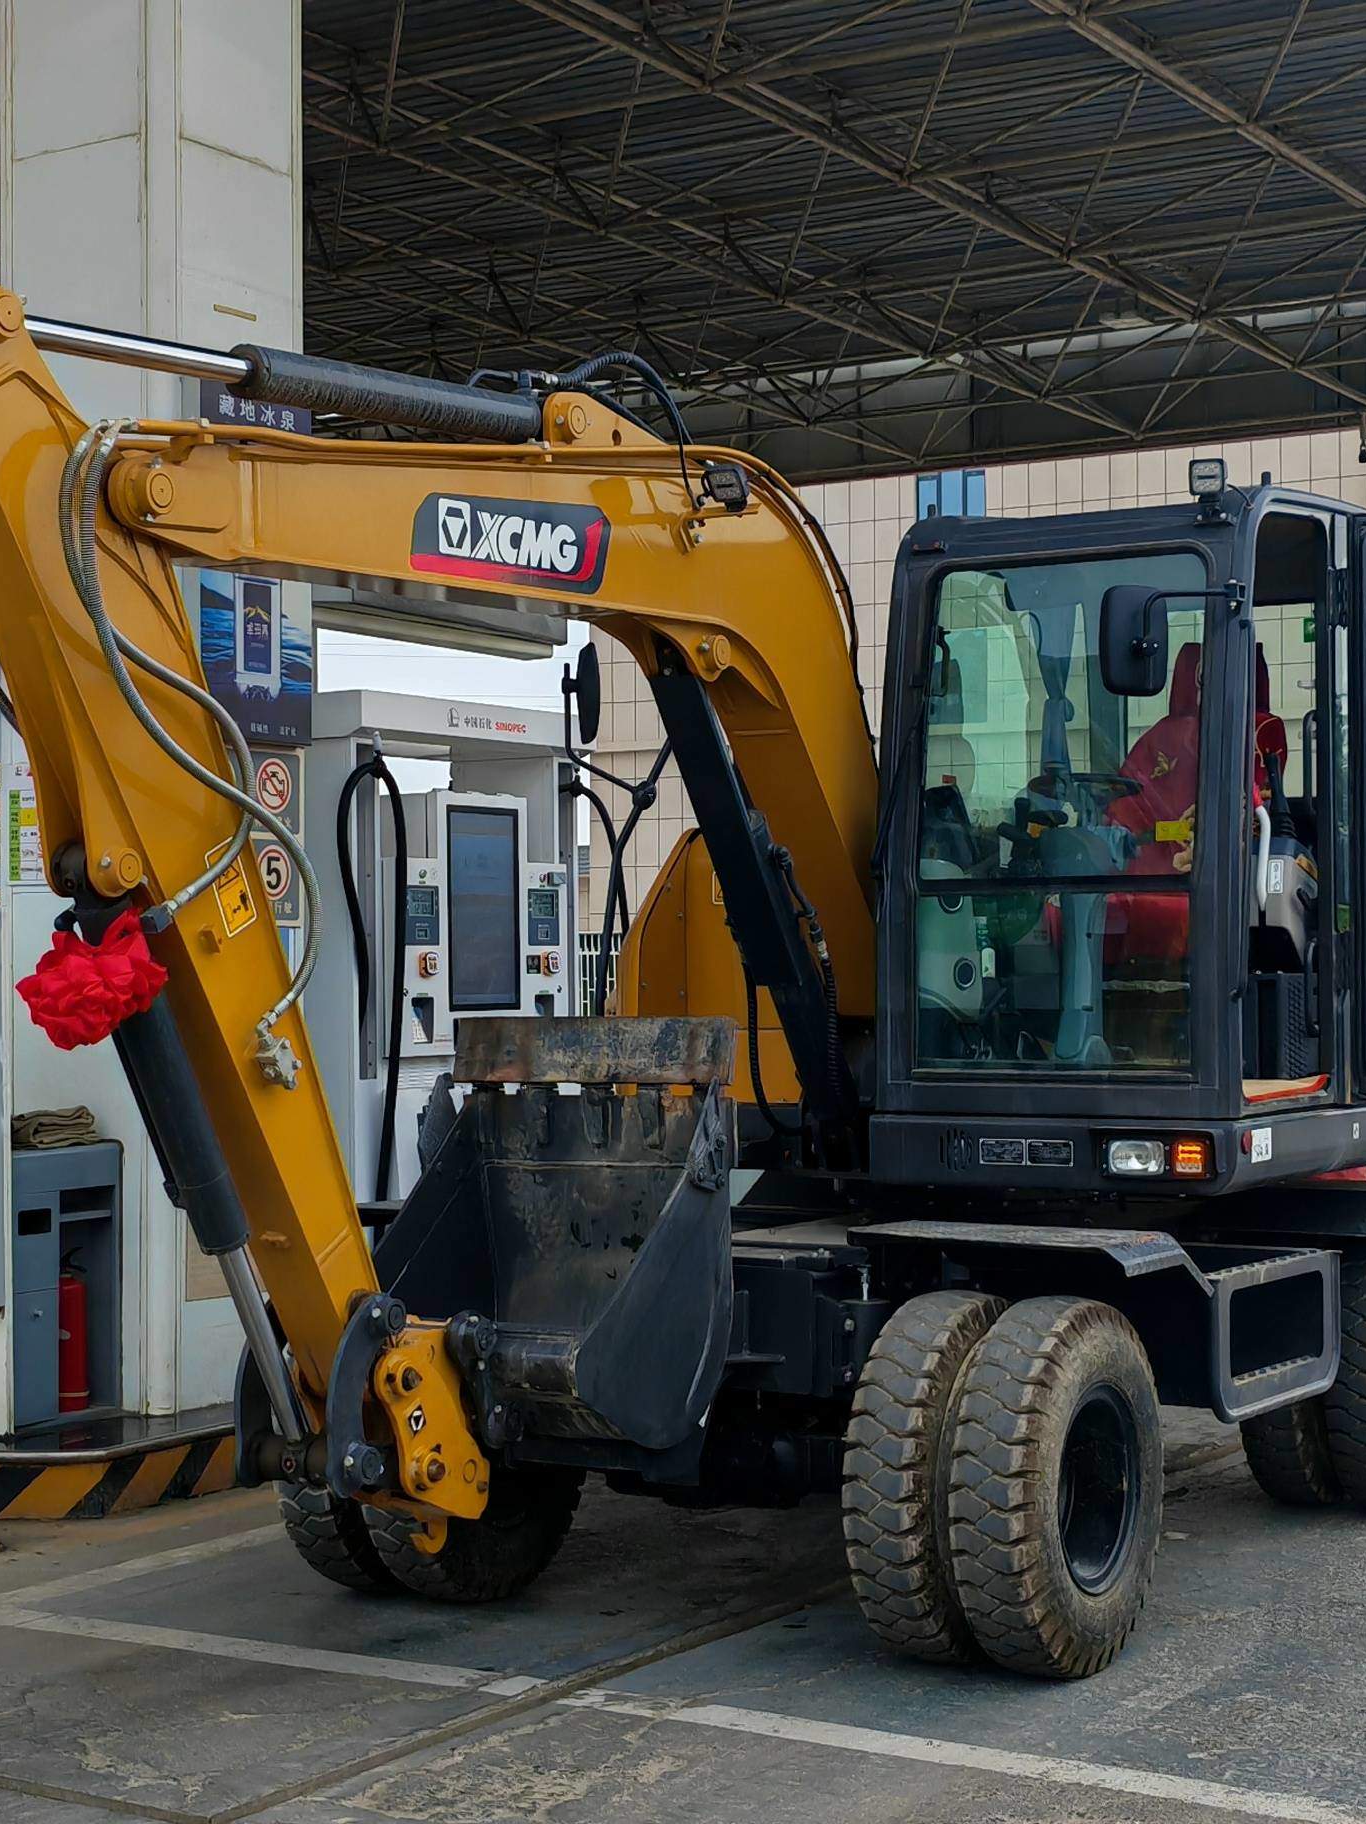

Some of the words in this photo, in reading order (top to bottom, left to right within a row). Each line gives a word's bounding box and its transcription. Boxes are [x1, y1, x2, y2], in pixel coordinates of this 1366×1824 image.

[218, 393, 296, 431] 藏地冰泉
[471, 510, 579, 573] XCMG
[495, 721, 527, 734] SINOPEC
[266, 856, 282, 890] 5
